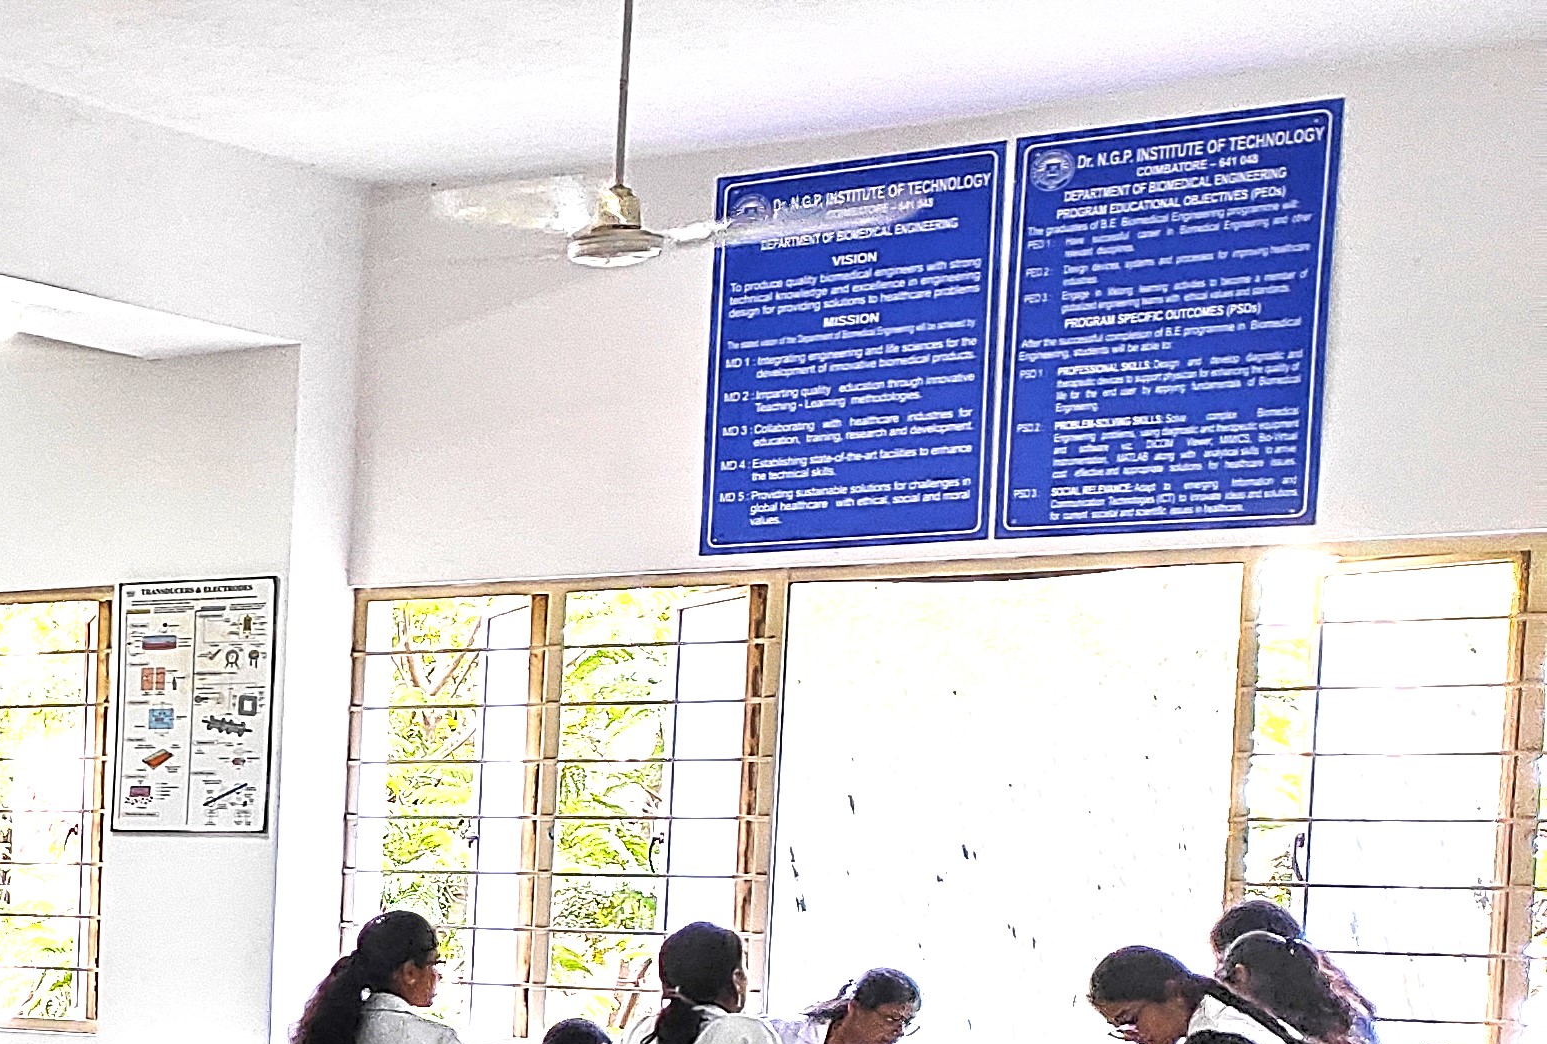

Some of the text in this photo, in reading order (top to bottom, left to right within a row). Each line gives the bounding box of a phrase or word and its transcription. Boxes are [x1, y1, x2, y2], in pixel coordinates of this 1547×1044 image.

[1097, 149, 1133, 166] N.G.P.
[1136, 140, 1204, 162] INSTITUTE
[1206, 138, 1226, 153] OF
[1228, 126, 1325, 151] TECHNOLOGY
[1136, 158, 1207, 176] COIMBATORE
[825, 185, 885, 207] INSTITUTE
[887, 182, 904, 197] OF
[907, 172, 991, 195] TECHNOLOGY
[1063, 166, 1287, 202] DEPARTMENT OF BIOMEDICAL ENGINEERING
[1056, 185, 1286, 219] PROGRAM EDUCATIONAL OBJECTIVES (PEOs)
[759, 217, 958, 250] DEPARTMENT OF BIOMEDICAL ENGINEERING
[831, 251, 877, 266] VISION
[823, 312, 879, 327] MISSION
[1063, 302, 1261, 328] PROGRAM SPECIFIC OUTCOMES (PSOs)
[744, 357, 749, 366] 1
[741, 390, 749, 401] 2
[740, 425, 747, 435] 3
[738, 459, 745, 468] 4
[737, 491, 744, 501] 5
[1050, 486, 1081, 496] SOCIAL
[1081, 482, 1133, 495] RELEVANCE:
